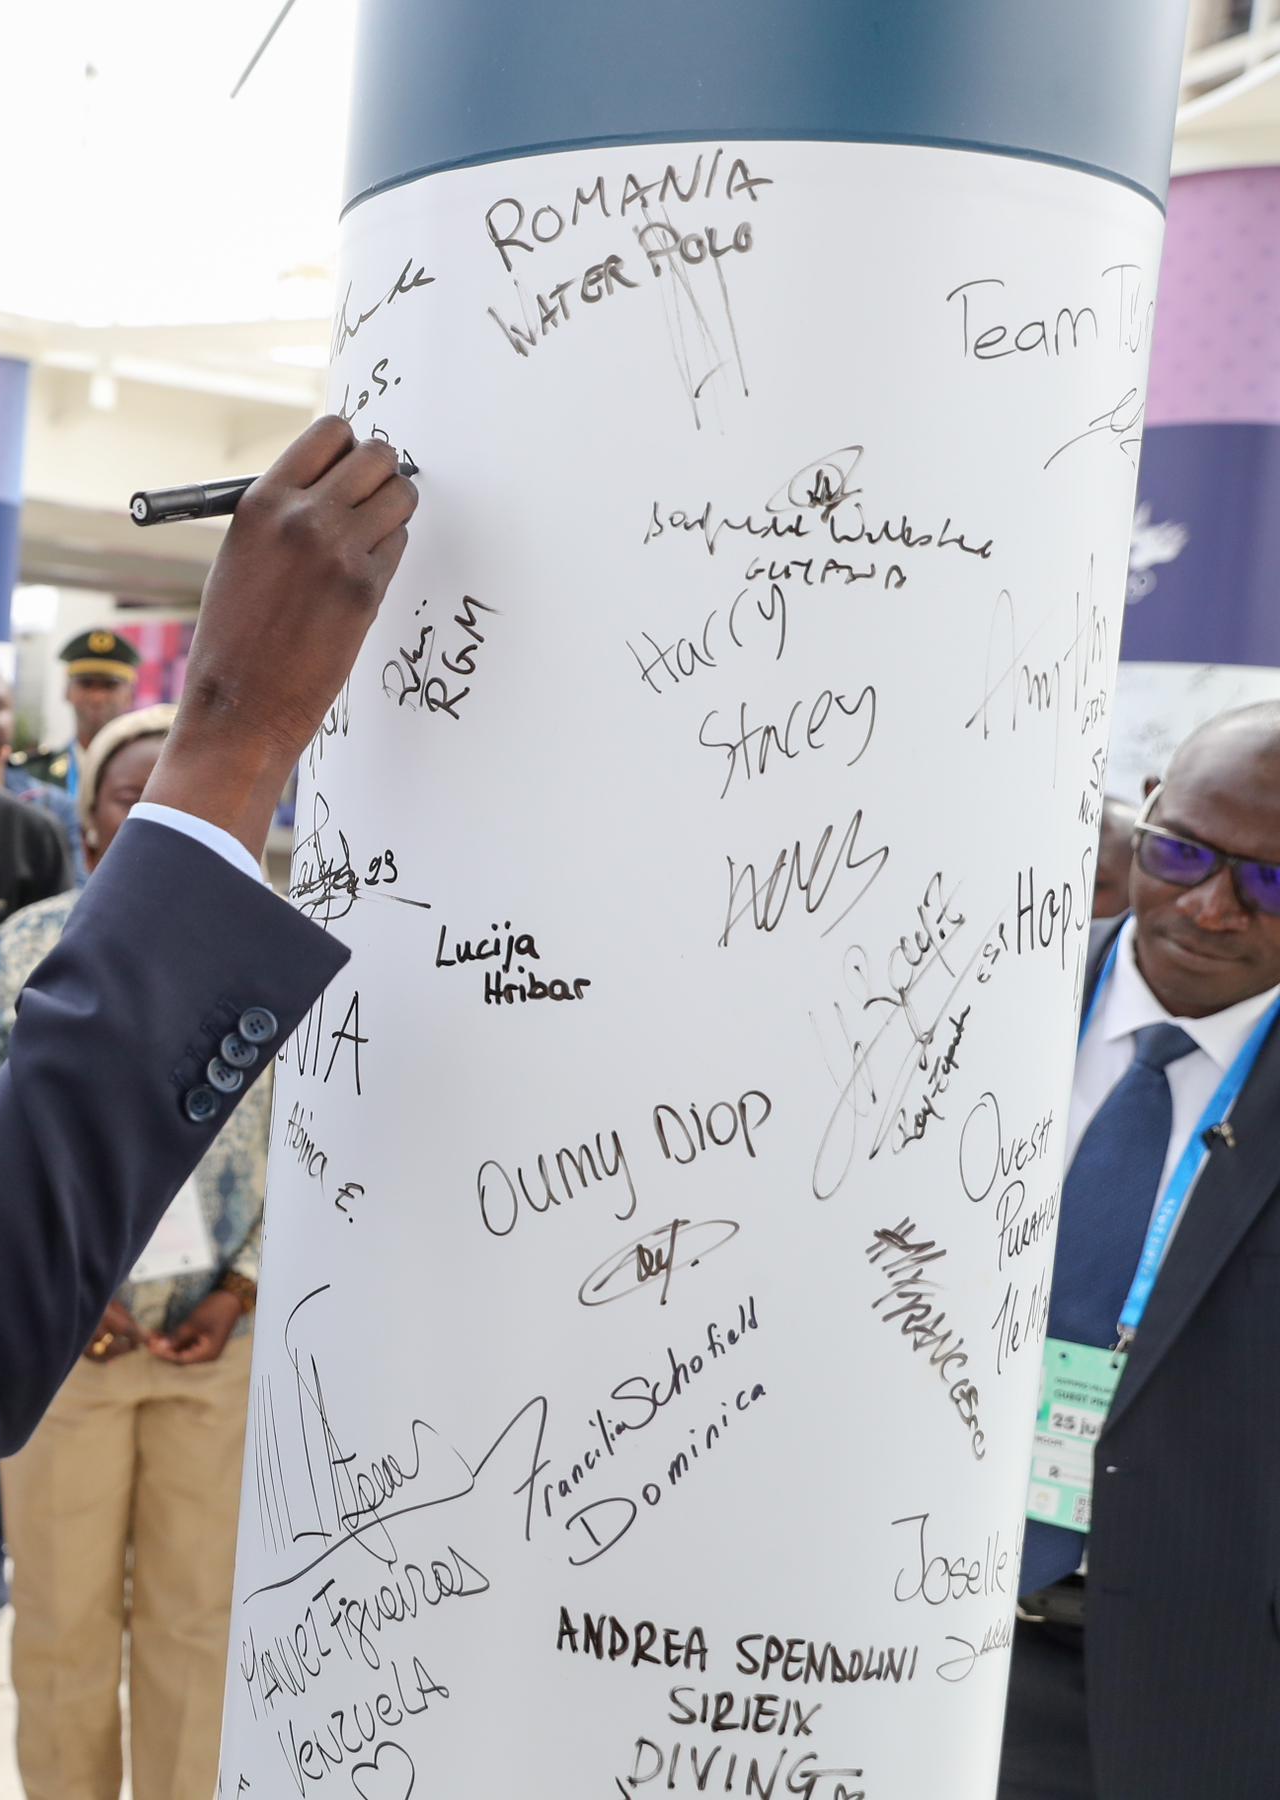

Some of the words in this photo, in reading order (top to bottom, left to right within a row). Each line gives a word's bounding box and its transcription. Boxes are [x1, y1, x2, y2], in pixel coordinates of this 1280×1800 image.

[485, 147, 774, 273] ROMANIA
[486, 253, 641, 358] WATER
[633, 220, 756, 278] POLO
[945, 277, 1099, 361] Team
[625, 582, 787, 694] Harry
[698, 684, 877, 800] Stacey
[435, 920, 541, 973] Lucija
[483, 965, 592, 1006] Hribar
[565, 1383, 767, 1567] Dominica
[890, 1511, 1009, 1606] Joselle
[555, 1605, 710, 1674] ANDREA
[667, 1685, 824, 1738] SIRIEIX
[624, 1735, 865, 1800] DIVING
